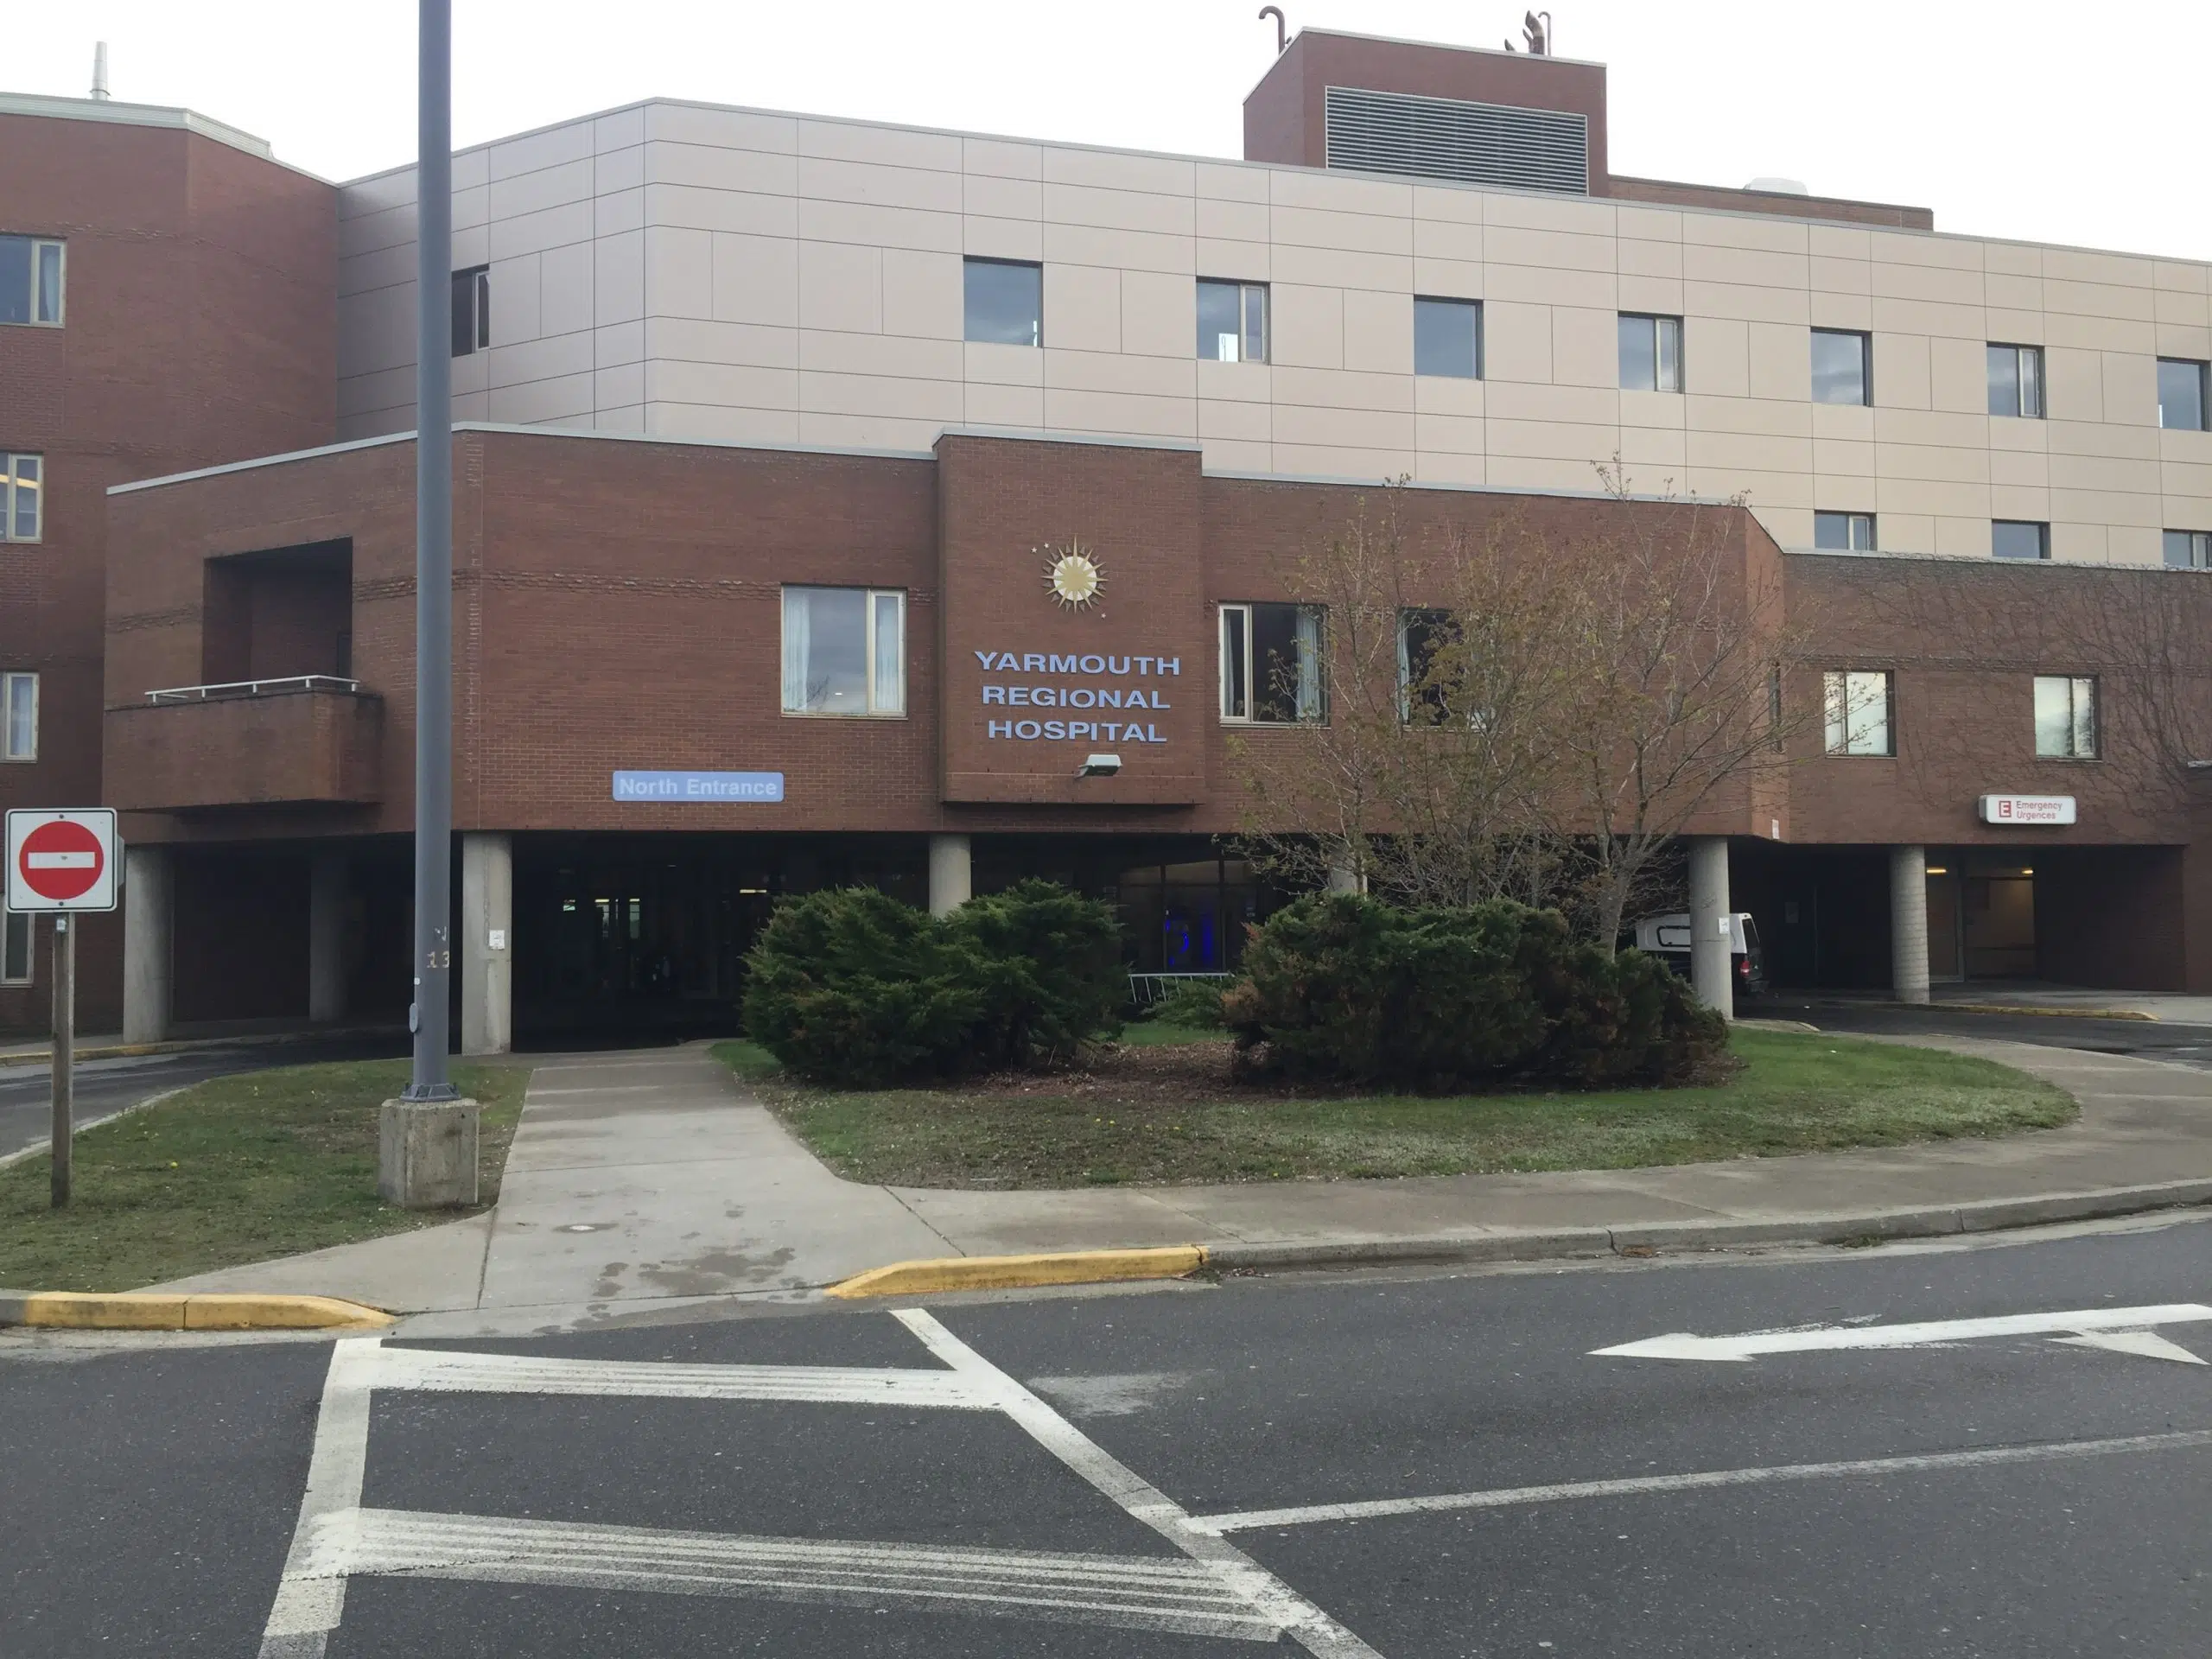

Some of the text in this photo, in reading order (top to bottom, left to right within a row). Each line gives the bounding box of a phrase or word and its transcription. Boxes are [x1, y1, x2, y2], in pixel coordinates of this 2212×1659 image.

[975, 651, 1180, 676] YARMOUTH
[982, 686, 1170, 709] REGIONAL
[988, 720, 1167, 742] HOSPITAL
[620, 779, 777, 795] North Entrance
[1999, 801, 2012, 817] E
[2017, 800, 2063, 810] Emergency
[2017, 810, 2056, 821] Urgences
